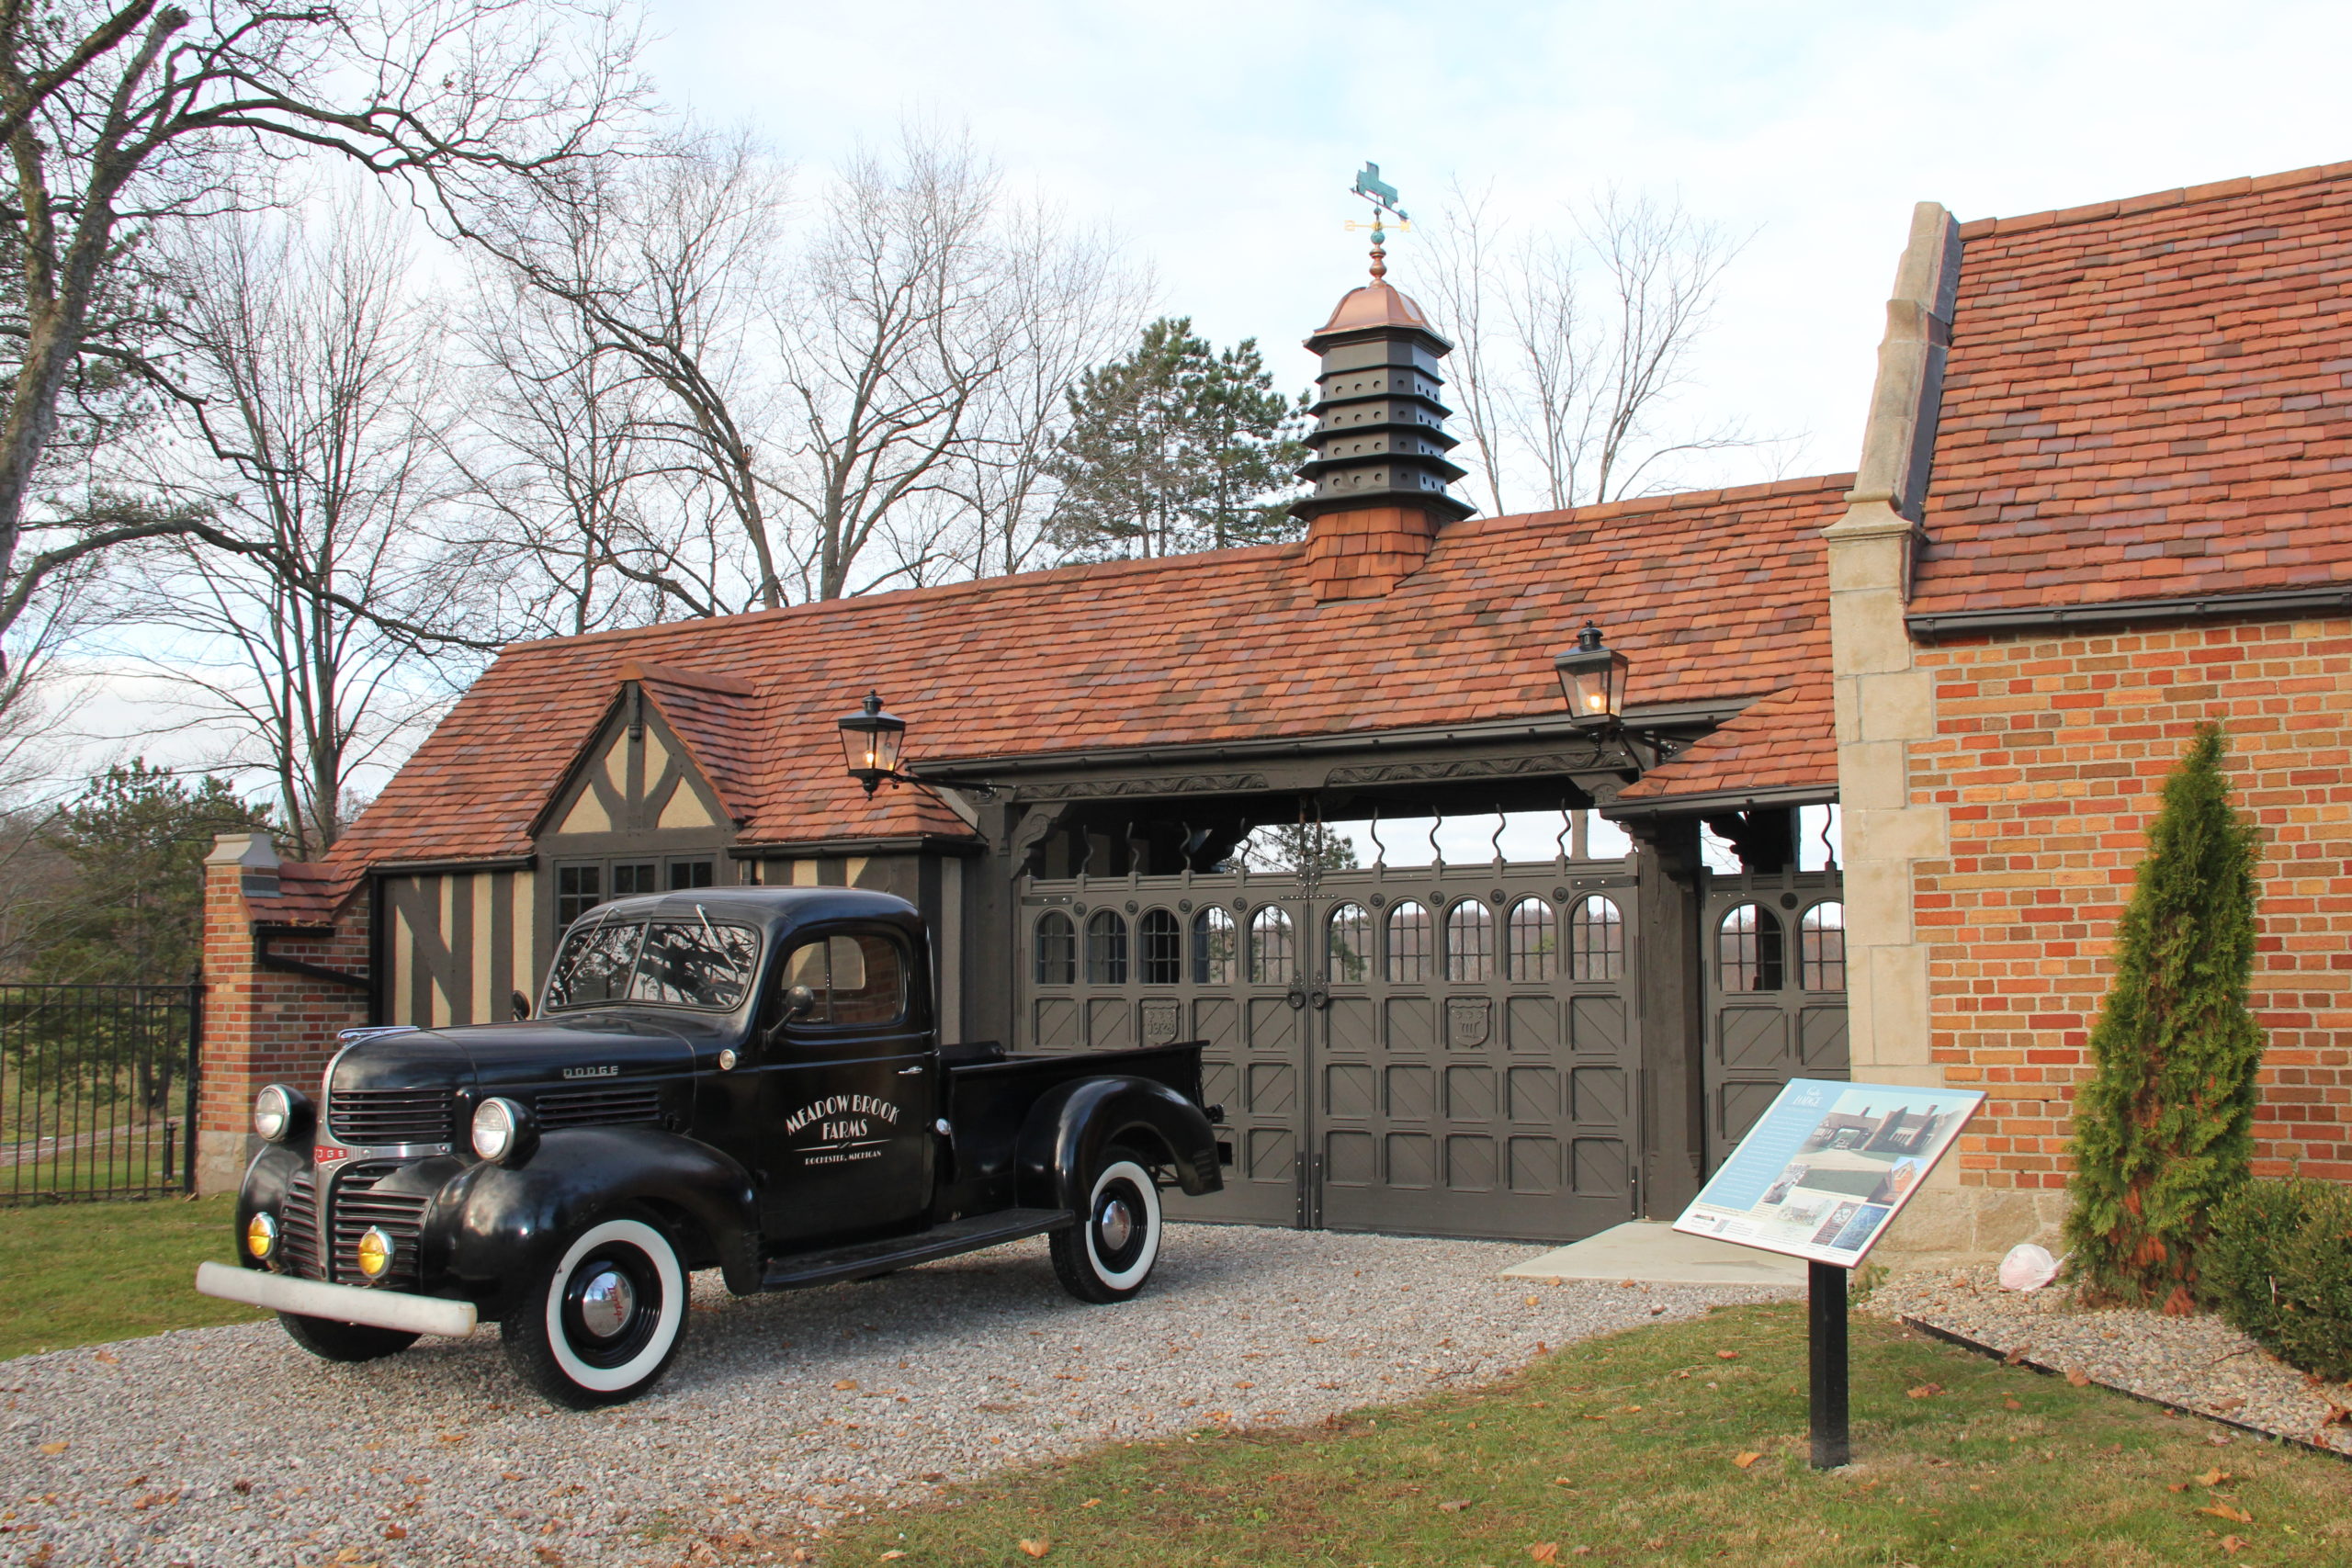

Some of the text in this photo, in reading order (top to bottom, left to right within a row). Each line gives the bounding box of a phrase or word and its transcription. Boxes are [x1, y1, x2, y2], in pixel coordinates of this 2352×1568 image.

[562, 1066, 619, 1077] DODGE
[786, 1094, 900, 1136] MEADOW BROOK
[822, 1119, 868, 1140] FARMS
[805, 1150, 882, 1166] ROCHESTER, MICHIGAN
